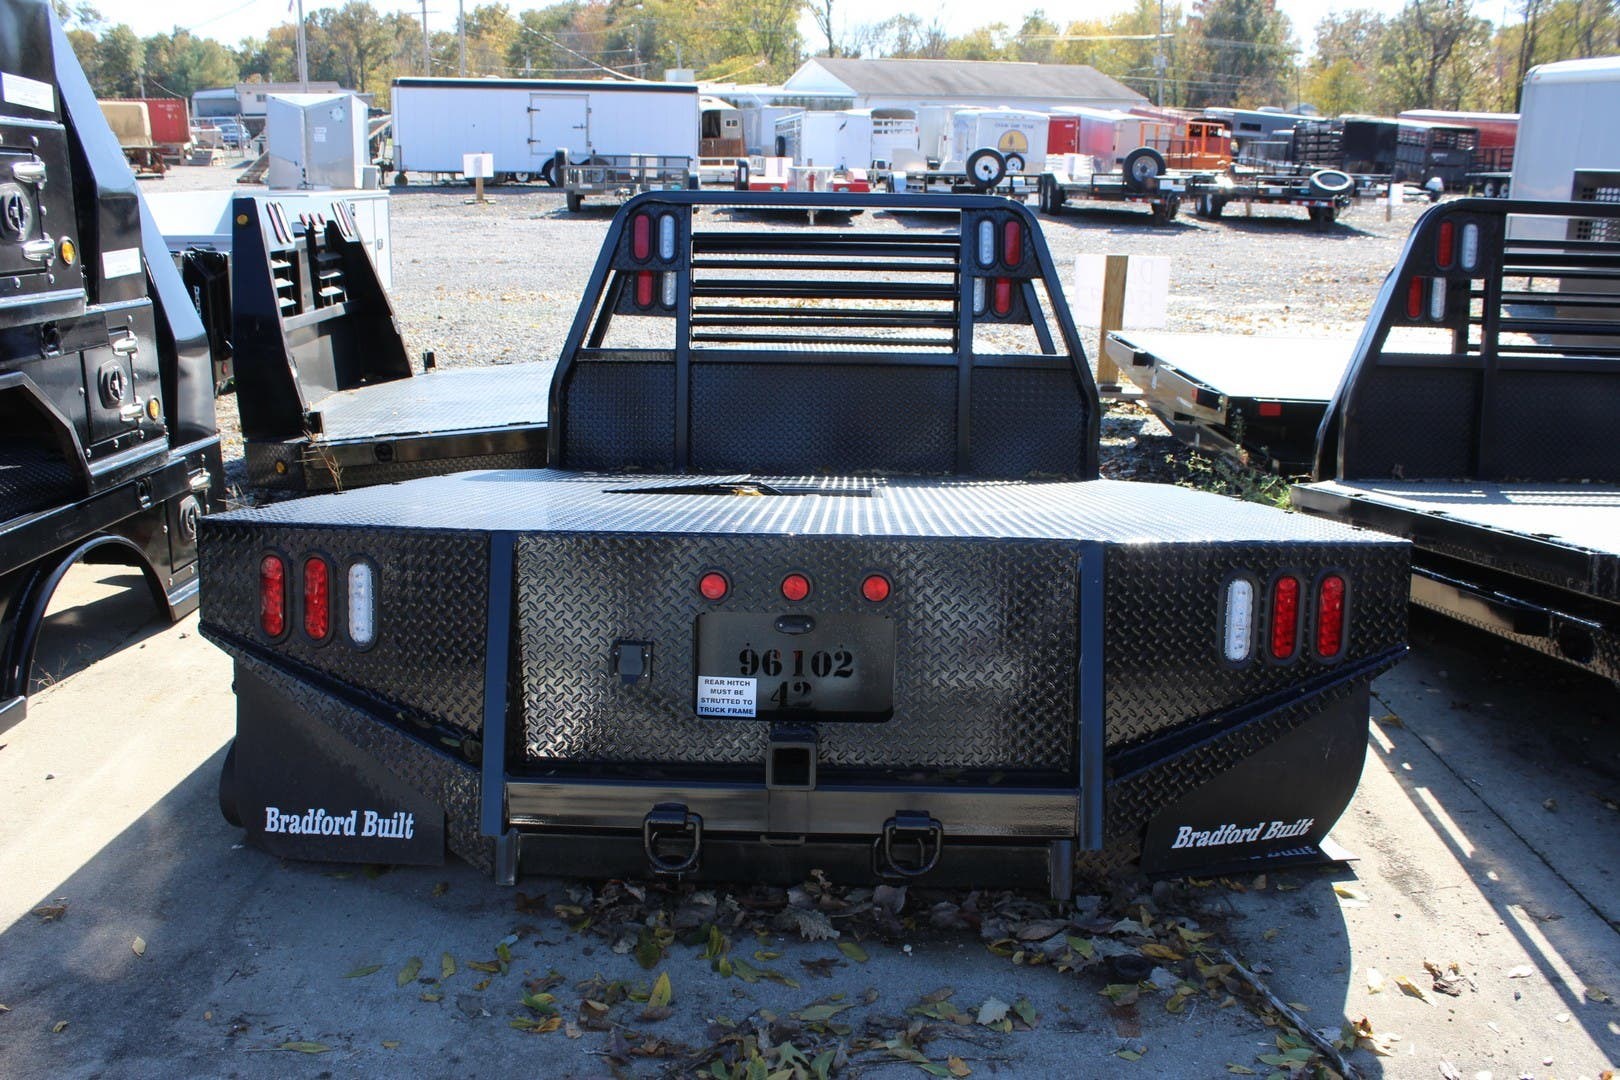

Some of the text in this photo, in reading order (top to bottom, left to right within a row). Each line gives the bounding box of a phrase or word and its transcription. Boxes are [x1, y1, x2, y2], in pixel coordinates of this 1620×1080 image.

[699, 706, 754, 715] TRUCK FRAME
[700, 697, 741, 705] STRUTTED
[264, 807, 414, 839] Bradford Built
[1171, 818, 1315, 849] Bradford Built
